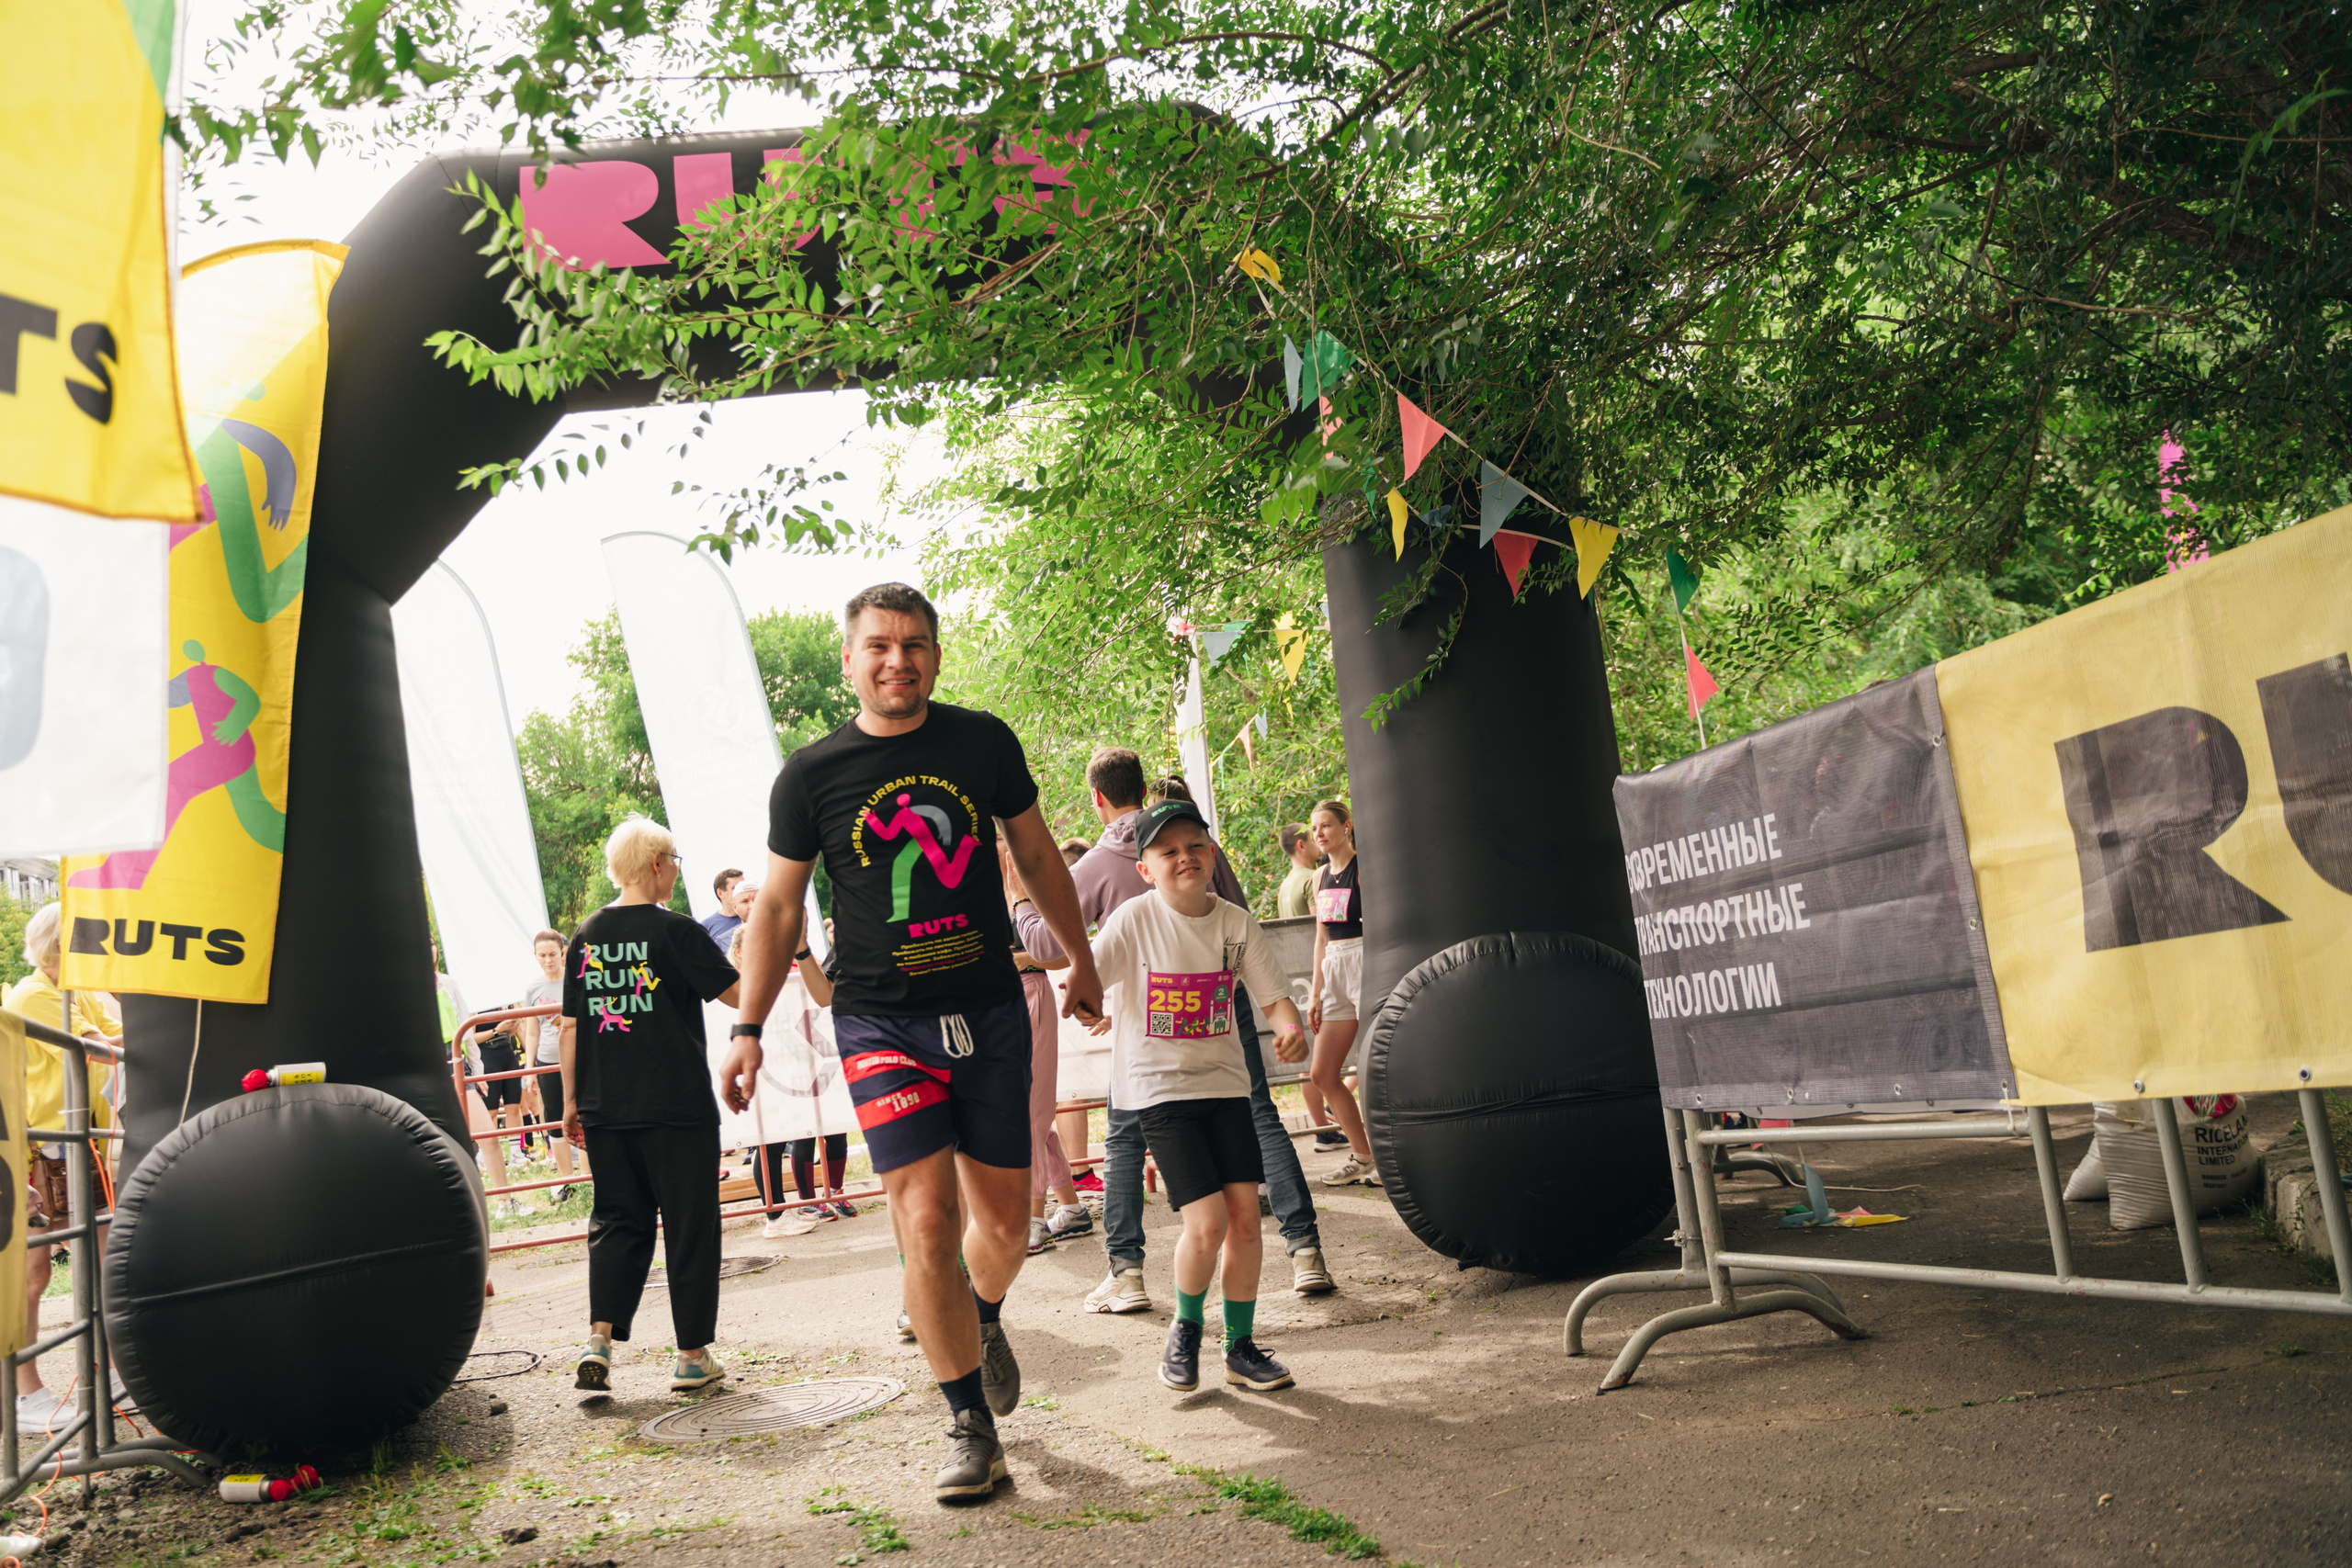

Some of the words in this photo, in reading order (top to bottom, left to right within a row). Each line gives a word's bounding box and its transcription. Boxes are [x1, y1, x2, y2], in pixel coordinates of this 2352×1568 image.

[852, 806, 871, 867] RUSSIAN
[867, 775, 917, 806] URBAN
[920, 775, 959, 797] TRAIL
[908, 913, 968, 938] RUTS
[69, 917, 245, 966] RUTS
[583, 942, 648, 964] RUN
[584, 968, 649, 990] RUN
[1148, 989, 1202, 1012] 255
[1218, 987, 1225, 996] 2
[588, 993, 653, 1016] RUN
[880, 1055, 899, 1064] POLO
[899, 1055, 917, 1066] CLUB
[876, 1092, 902, 1107] SINCE
[892, 1091, 920, 1112] 1890
[2198, 1155, 2235, 1166] LIMITED
